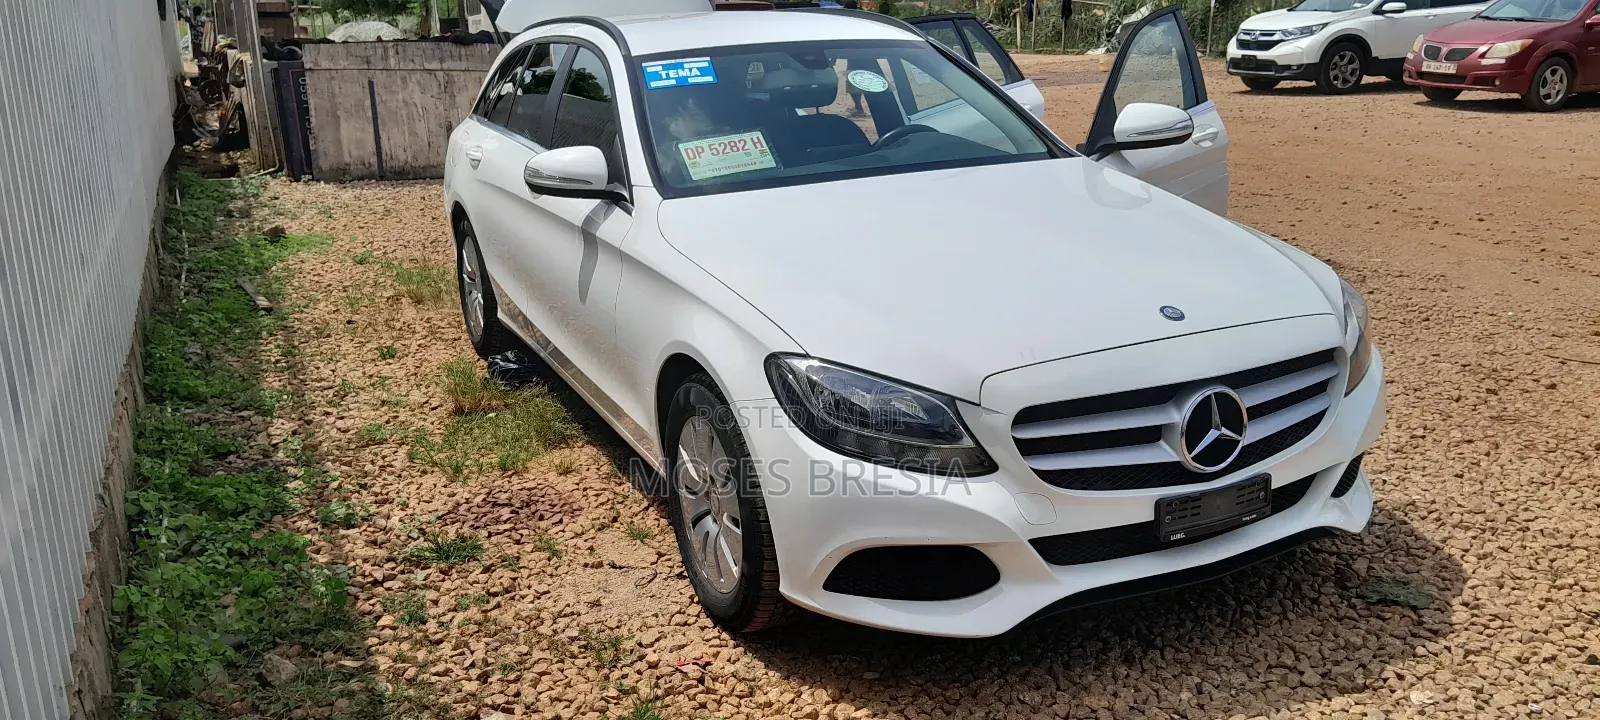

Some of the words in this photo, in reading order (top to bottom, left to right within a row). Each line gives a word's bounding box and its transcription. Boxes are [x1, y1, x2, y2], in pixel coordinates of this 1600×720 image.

[658, 67, 701, 79] TEMA
[684, 146, 705, 161] DP
[708, 139, 750, 156] 5282
[750, 136, 765, 149] H
